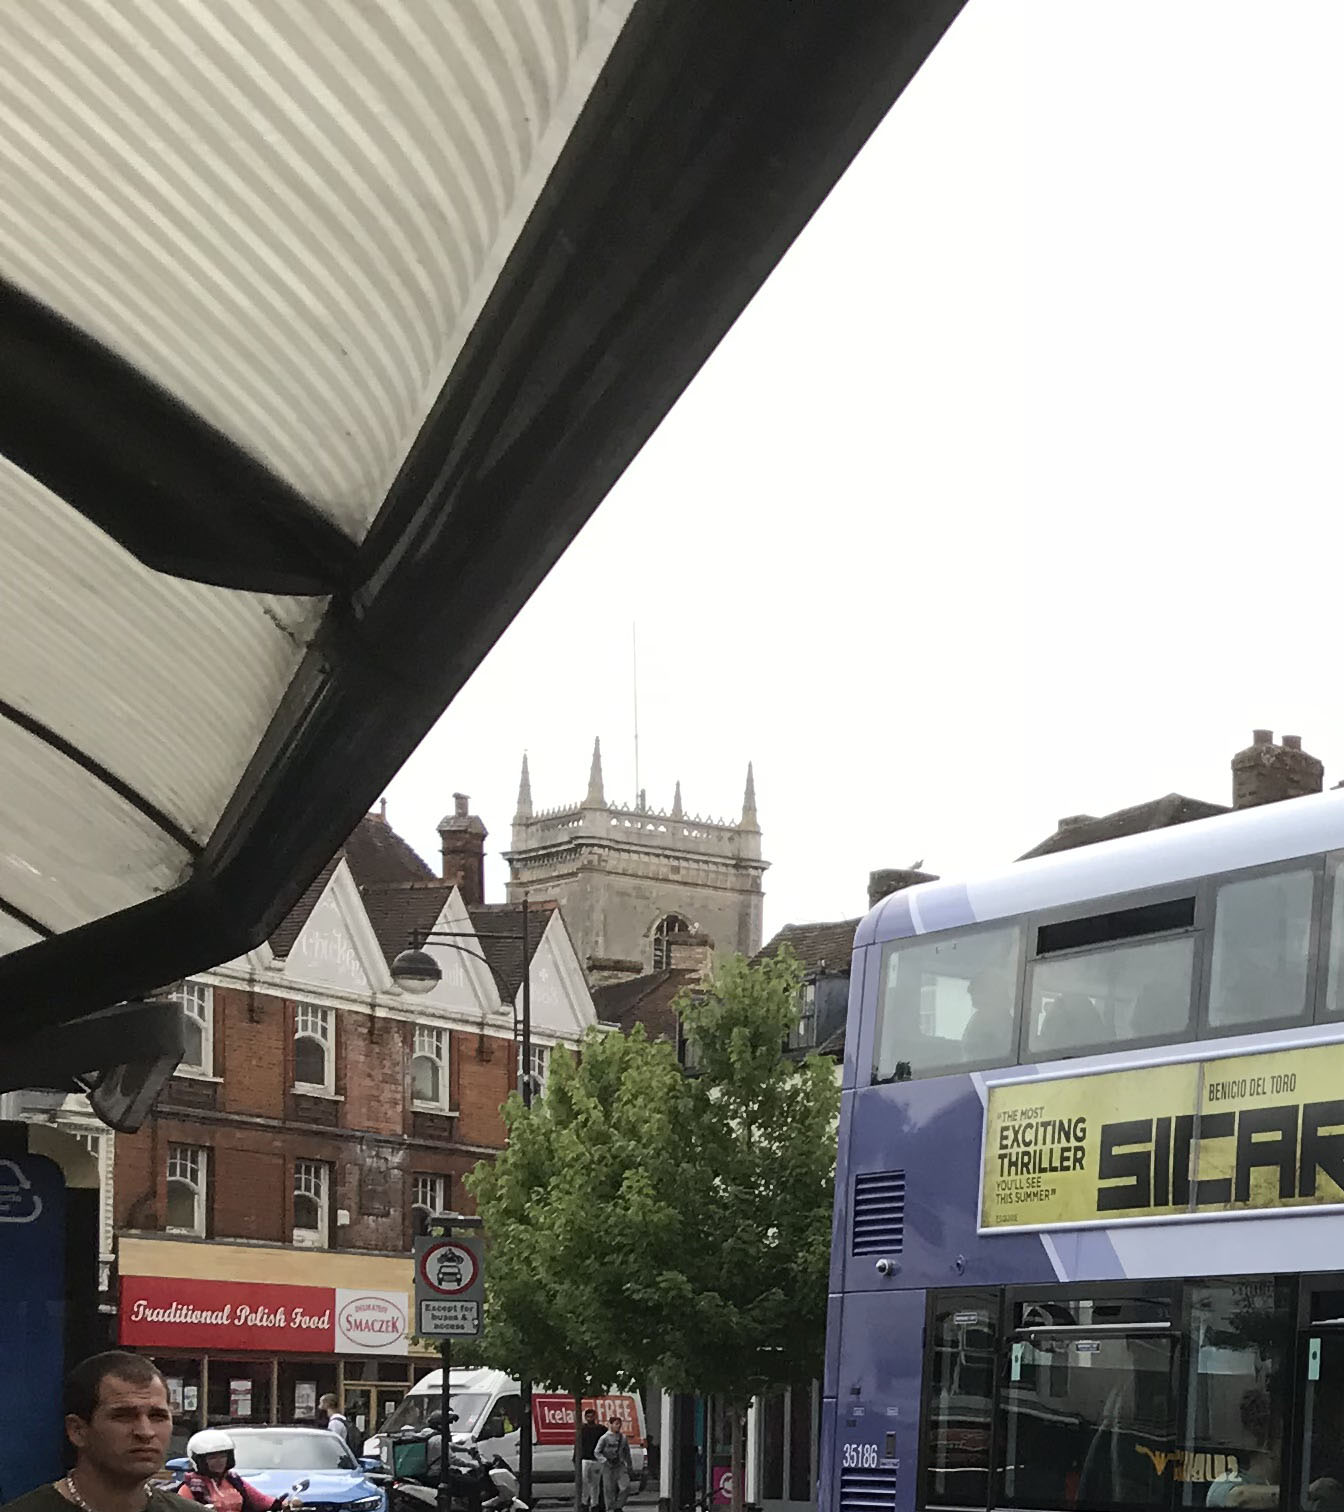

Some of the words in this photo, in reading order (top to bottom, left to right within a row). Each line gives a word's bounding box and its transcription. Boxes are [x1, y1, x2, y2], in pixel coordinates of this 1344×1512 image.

[1208, 1079, 1246, 1102] BENICIO
[1250, 1077, 1267, 1097] DEL
[1270, 1073, 1297, 1094] TORO
[1020, 1106, 1045, 1121] MOST
[999, 1116, 1087, 1150] EXCITING
[998, 1145, 1086, 1177] THRILLER
[996, 1179, 1024, 1191] YOU'LL
[1026, 1176, 1042, 1189] SEE
[996, 1192, 1013, 1205] THIS
[131, 1299, 231, 1326] Traditional
[235, 1305, 286, 1328] Polish
[290, 1308, 331, 1330] Food
[425, 1304, 458, 1314] Except
[460, 1304, 474, 1313] for
[345, 1313, 400, 1334] SMACZEK
[544, 1406, 591, 1424] Icela
[597, 1399, 632, 1420] FREE
[842, 1443, 878, 1468] 35186
